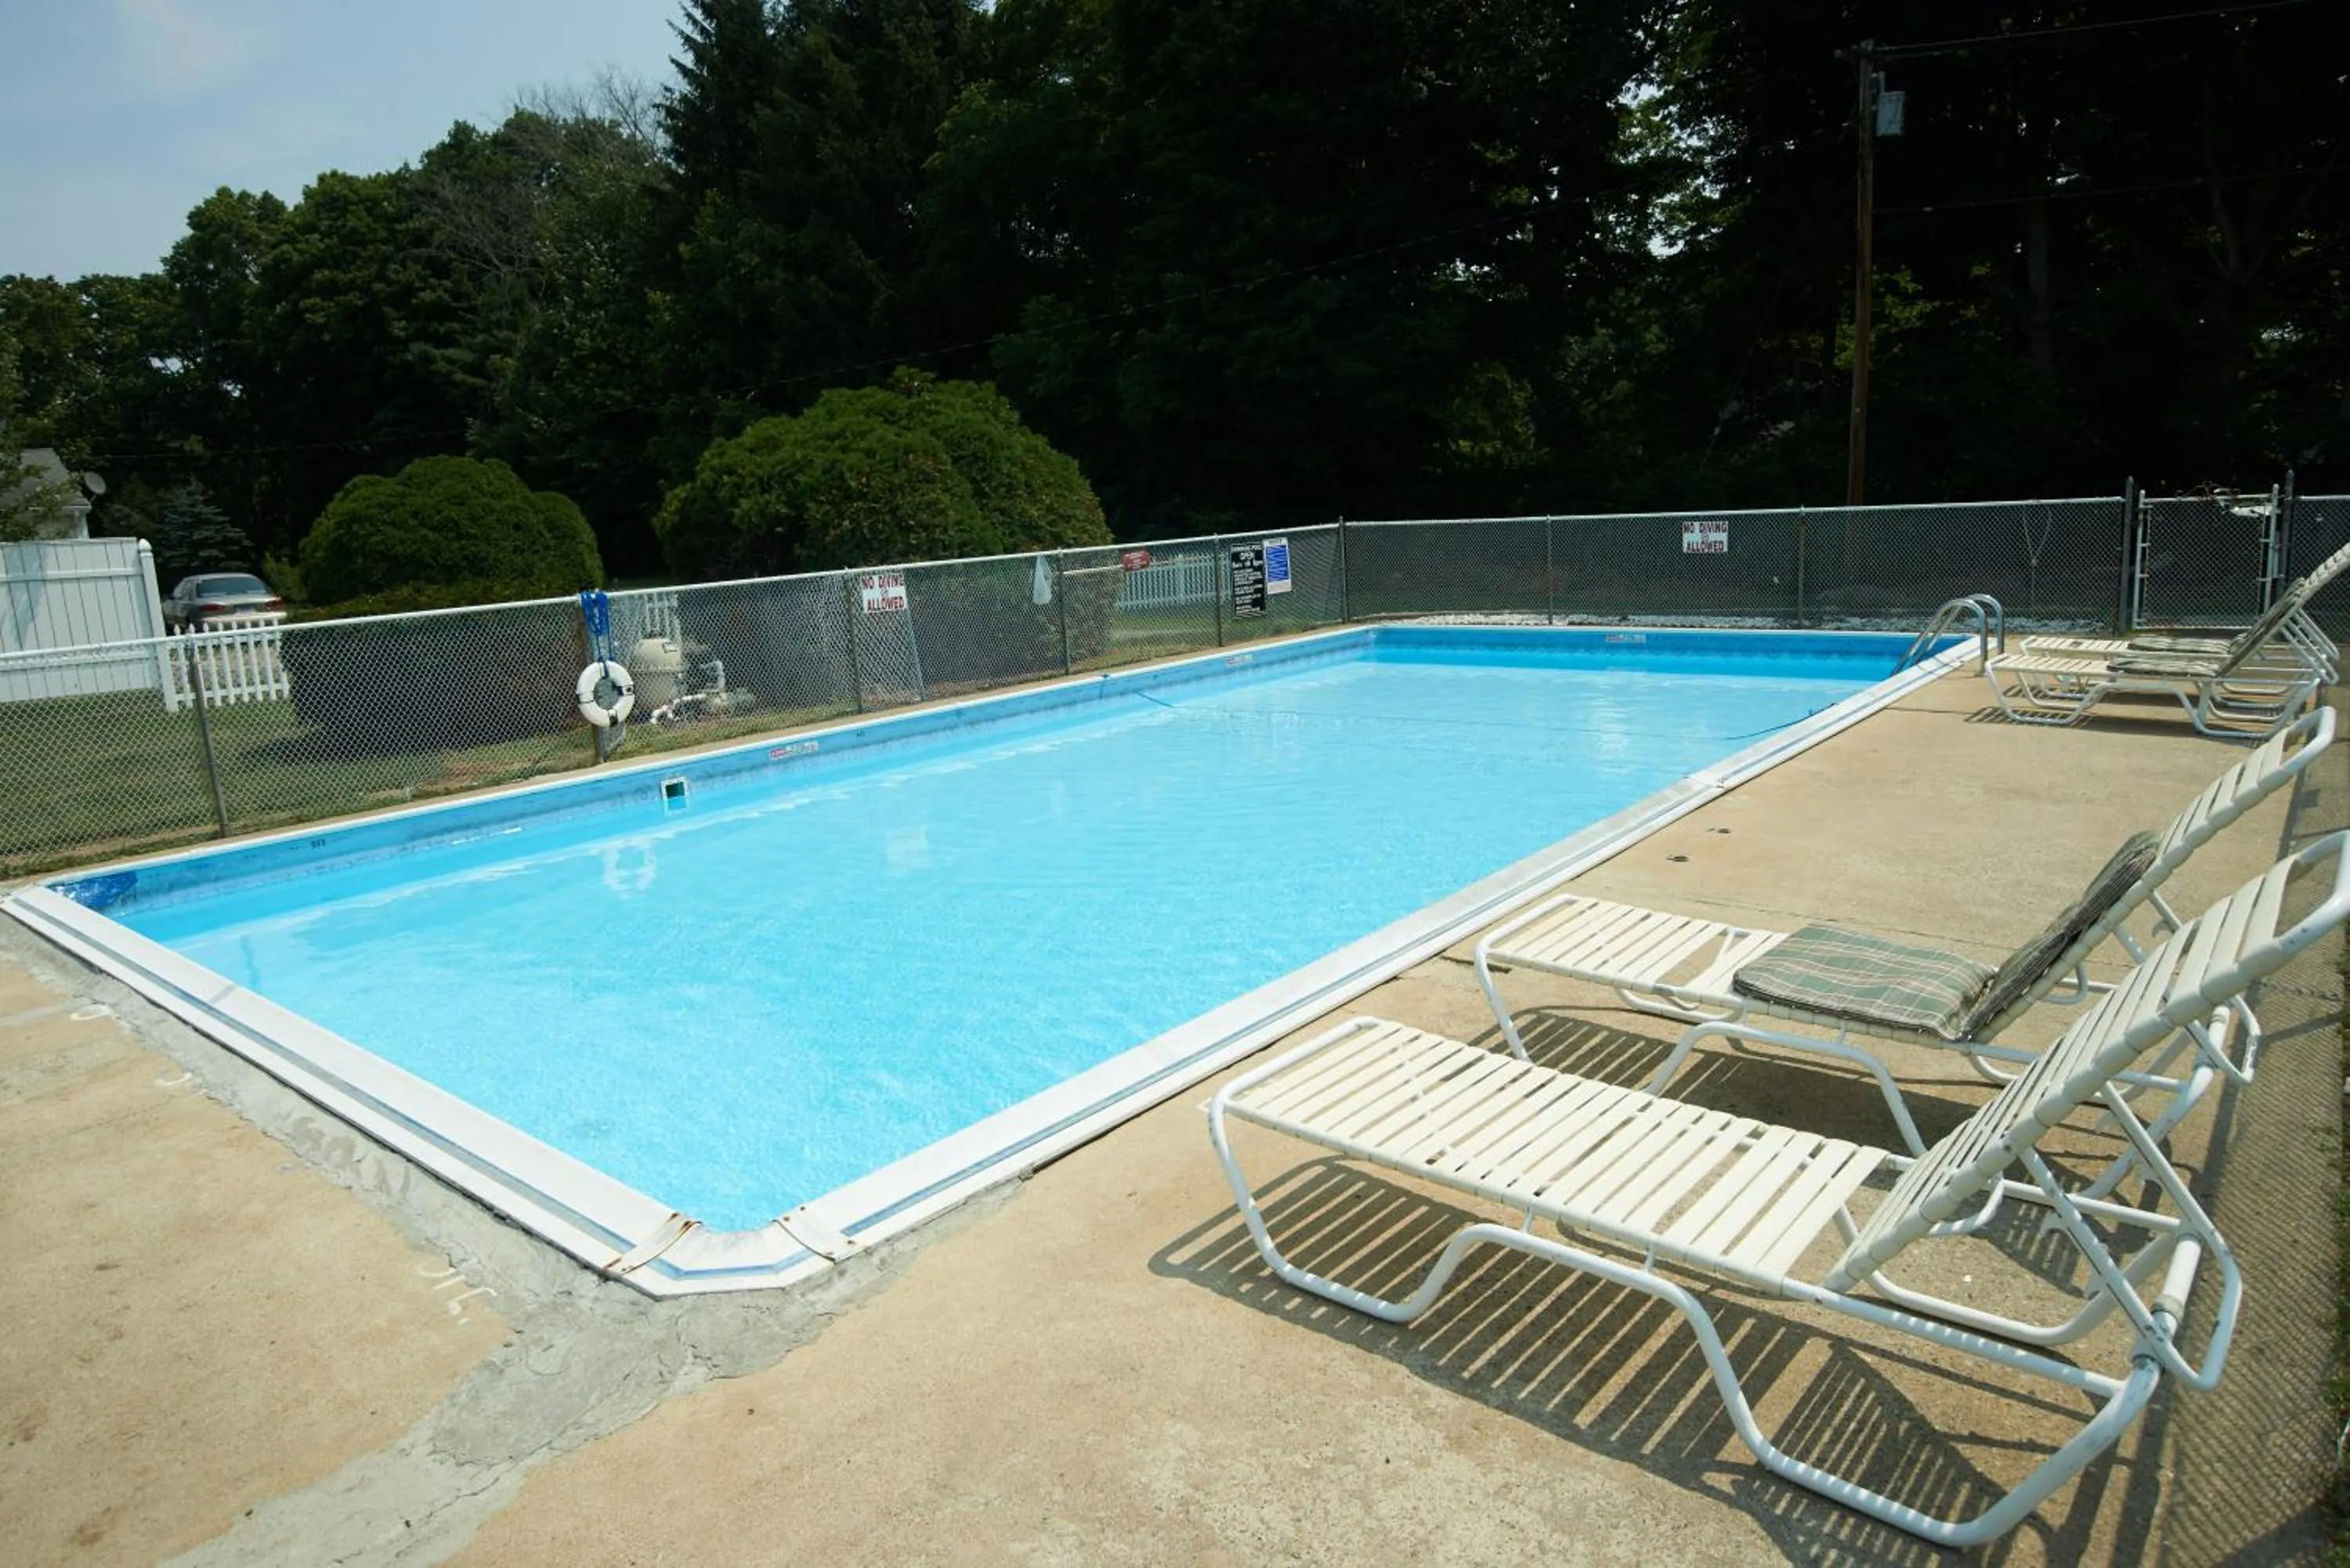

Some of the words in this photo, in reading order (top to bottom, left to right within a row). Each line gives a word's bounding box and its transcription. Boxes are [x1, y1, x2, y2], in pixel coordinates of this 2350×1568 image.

[1683, 522, 1695, 533] NO
[1699, 522, 1727, 533] DIVING
[1687, 540, 1724, 552] ALLOWED
[862, 576, 874, 589] NO
[878, 574, 904, 588] DIVING
[866, 596, 904, 611] ALLOWED
